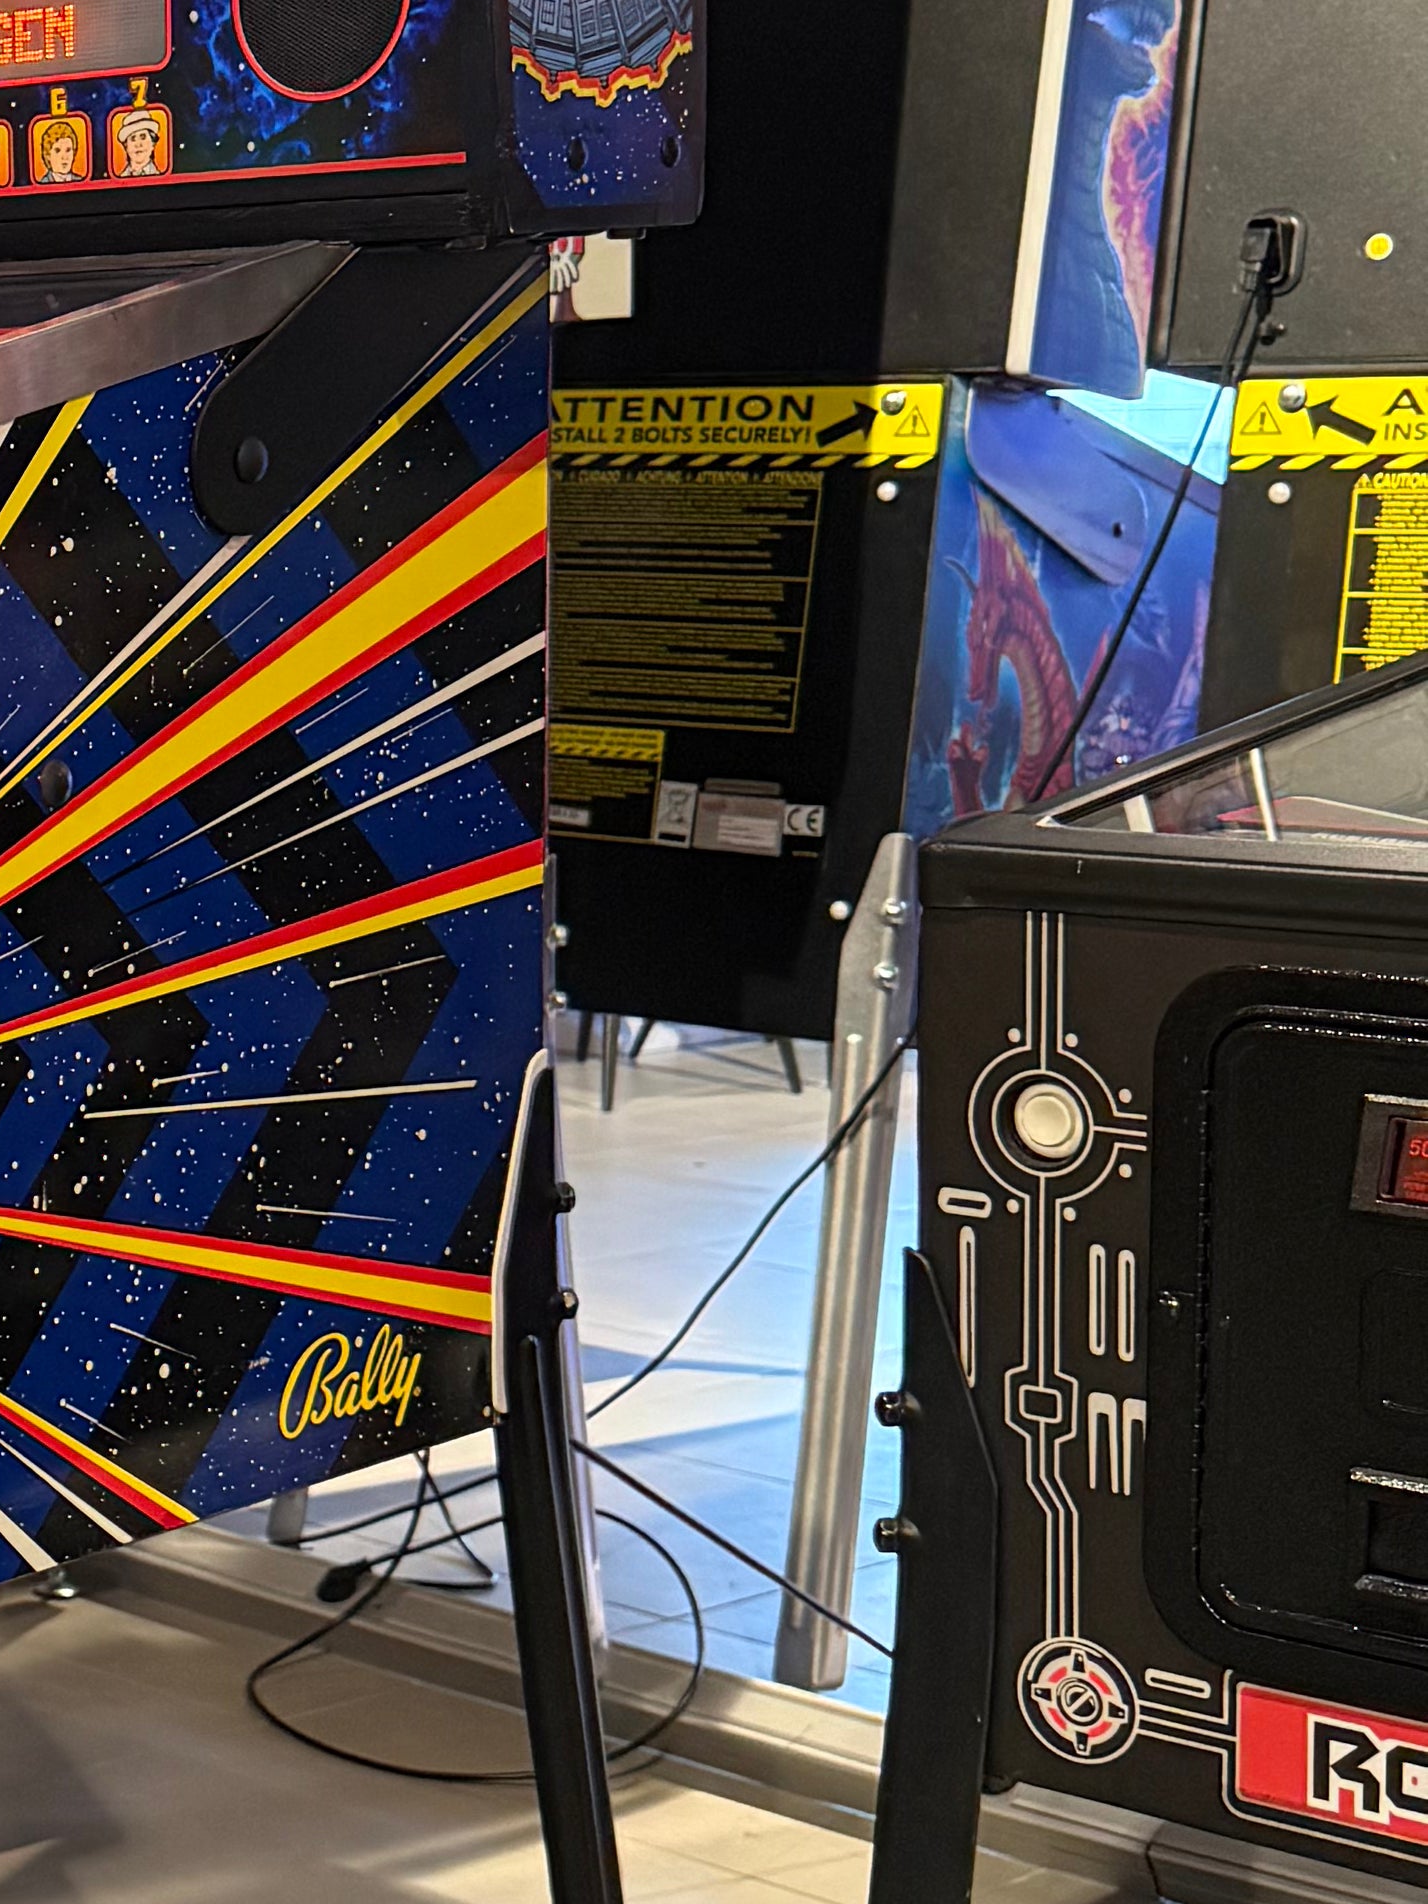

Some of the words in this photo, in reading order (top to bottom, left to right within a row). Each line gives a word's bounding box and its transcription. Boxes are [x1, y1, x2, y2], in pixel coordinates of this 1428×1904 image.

[49, 87, 69, 117] 6
[128, 77, 150, 109] 7
[552, 427, 611, 443] STALL
[614, 427, 626, 443] 2
[632, 427, 692, 443] BOLTS
[699, 427, 811, 444] SECURELY!
[279, 1323, 421, 1439] Bally
